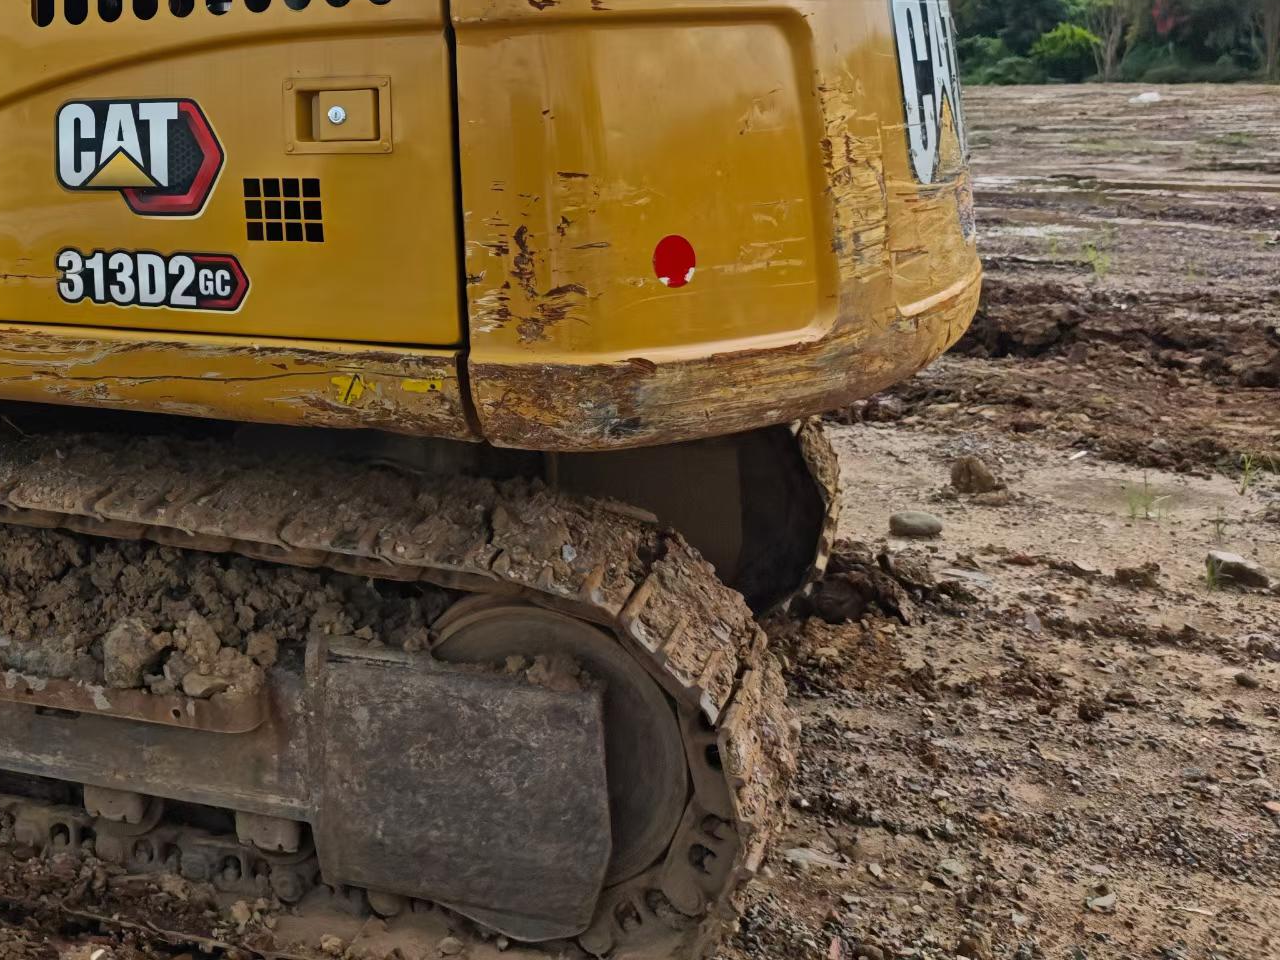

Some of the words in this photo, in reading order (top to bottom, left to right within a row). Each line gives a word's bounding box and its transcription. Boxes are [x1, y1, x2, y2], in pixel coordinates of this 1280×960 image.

[58, 101, 179, 187] CAT
[57, 249, 197, 307] 313D2
[198, 268, 232, 297] GC
